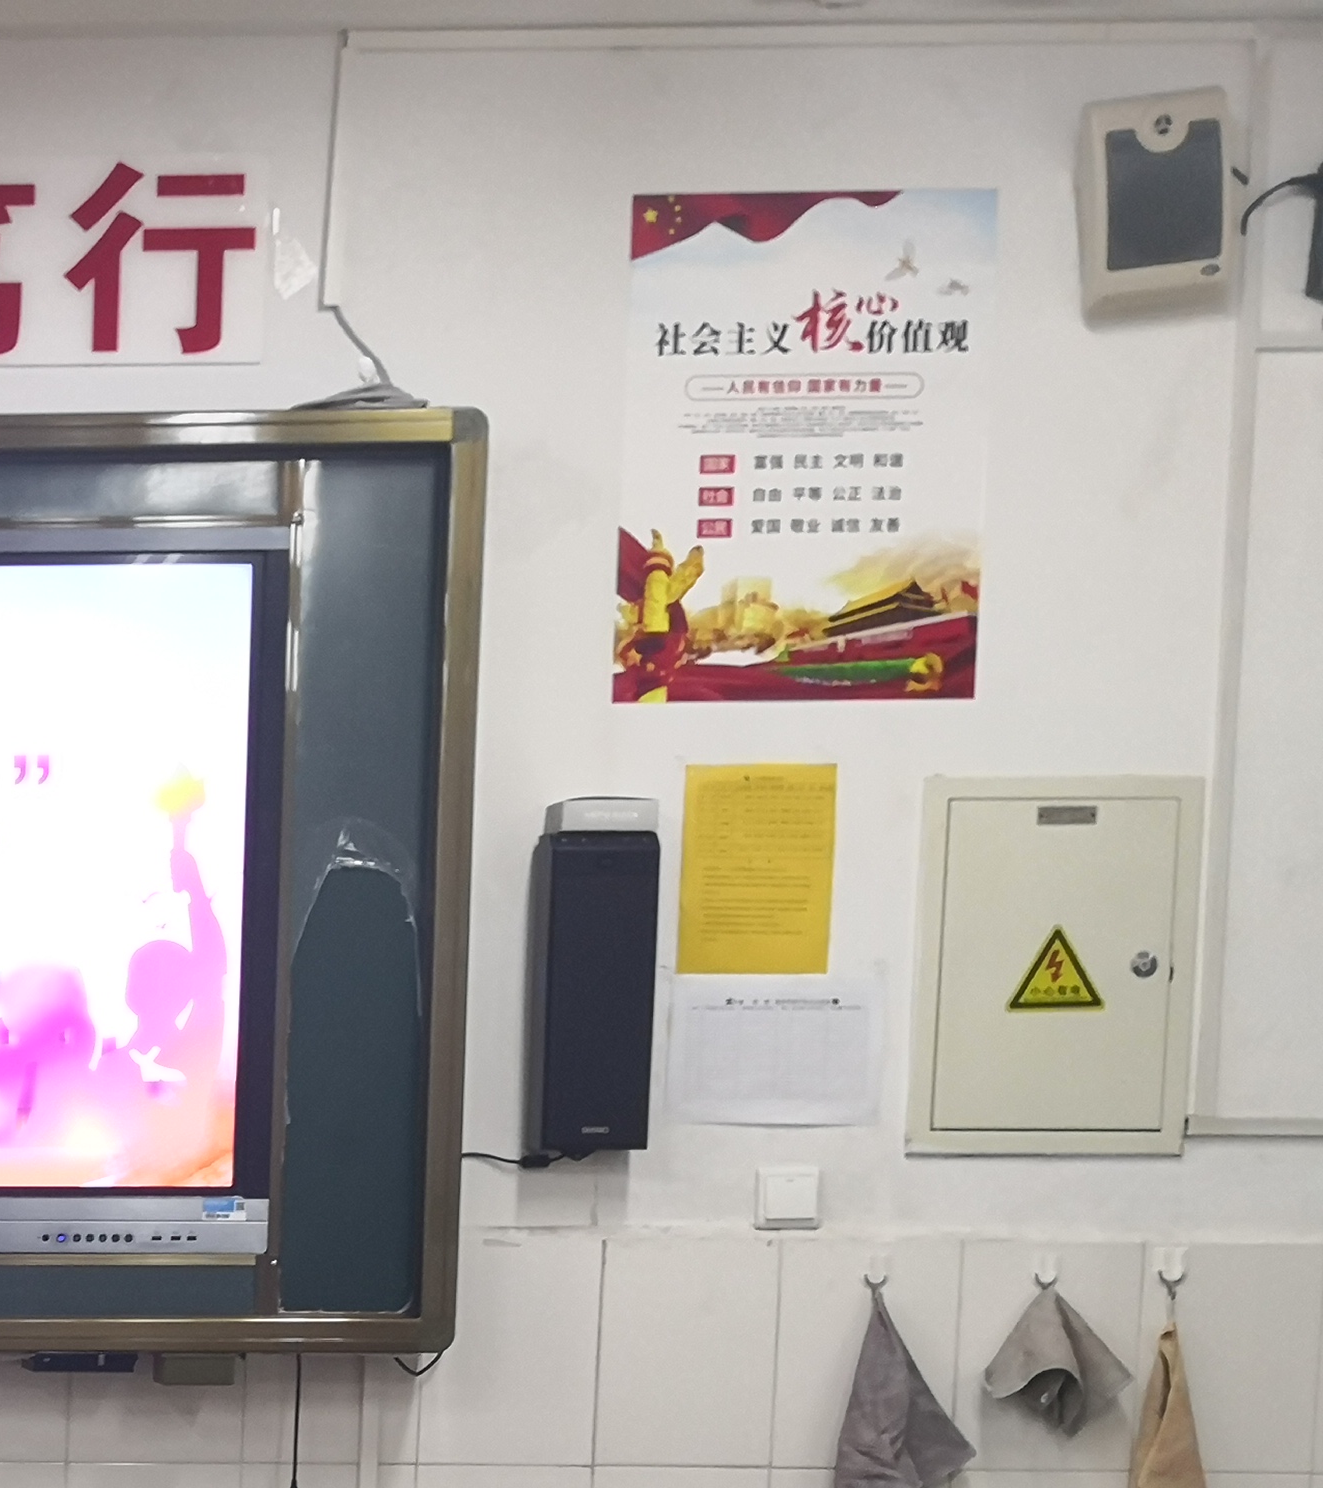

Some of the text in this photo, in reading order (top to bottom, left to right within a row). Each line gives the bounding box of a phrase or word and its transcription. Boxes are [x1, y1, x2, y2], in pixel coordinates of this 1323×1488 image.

[654, 289, 970, 357] 社会主义核心价值观
